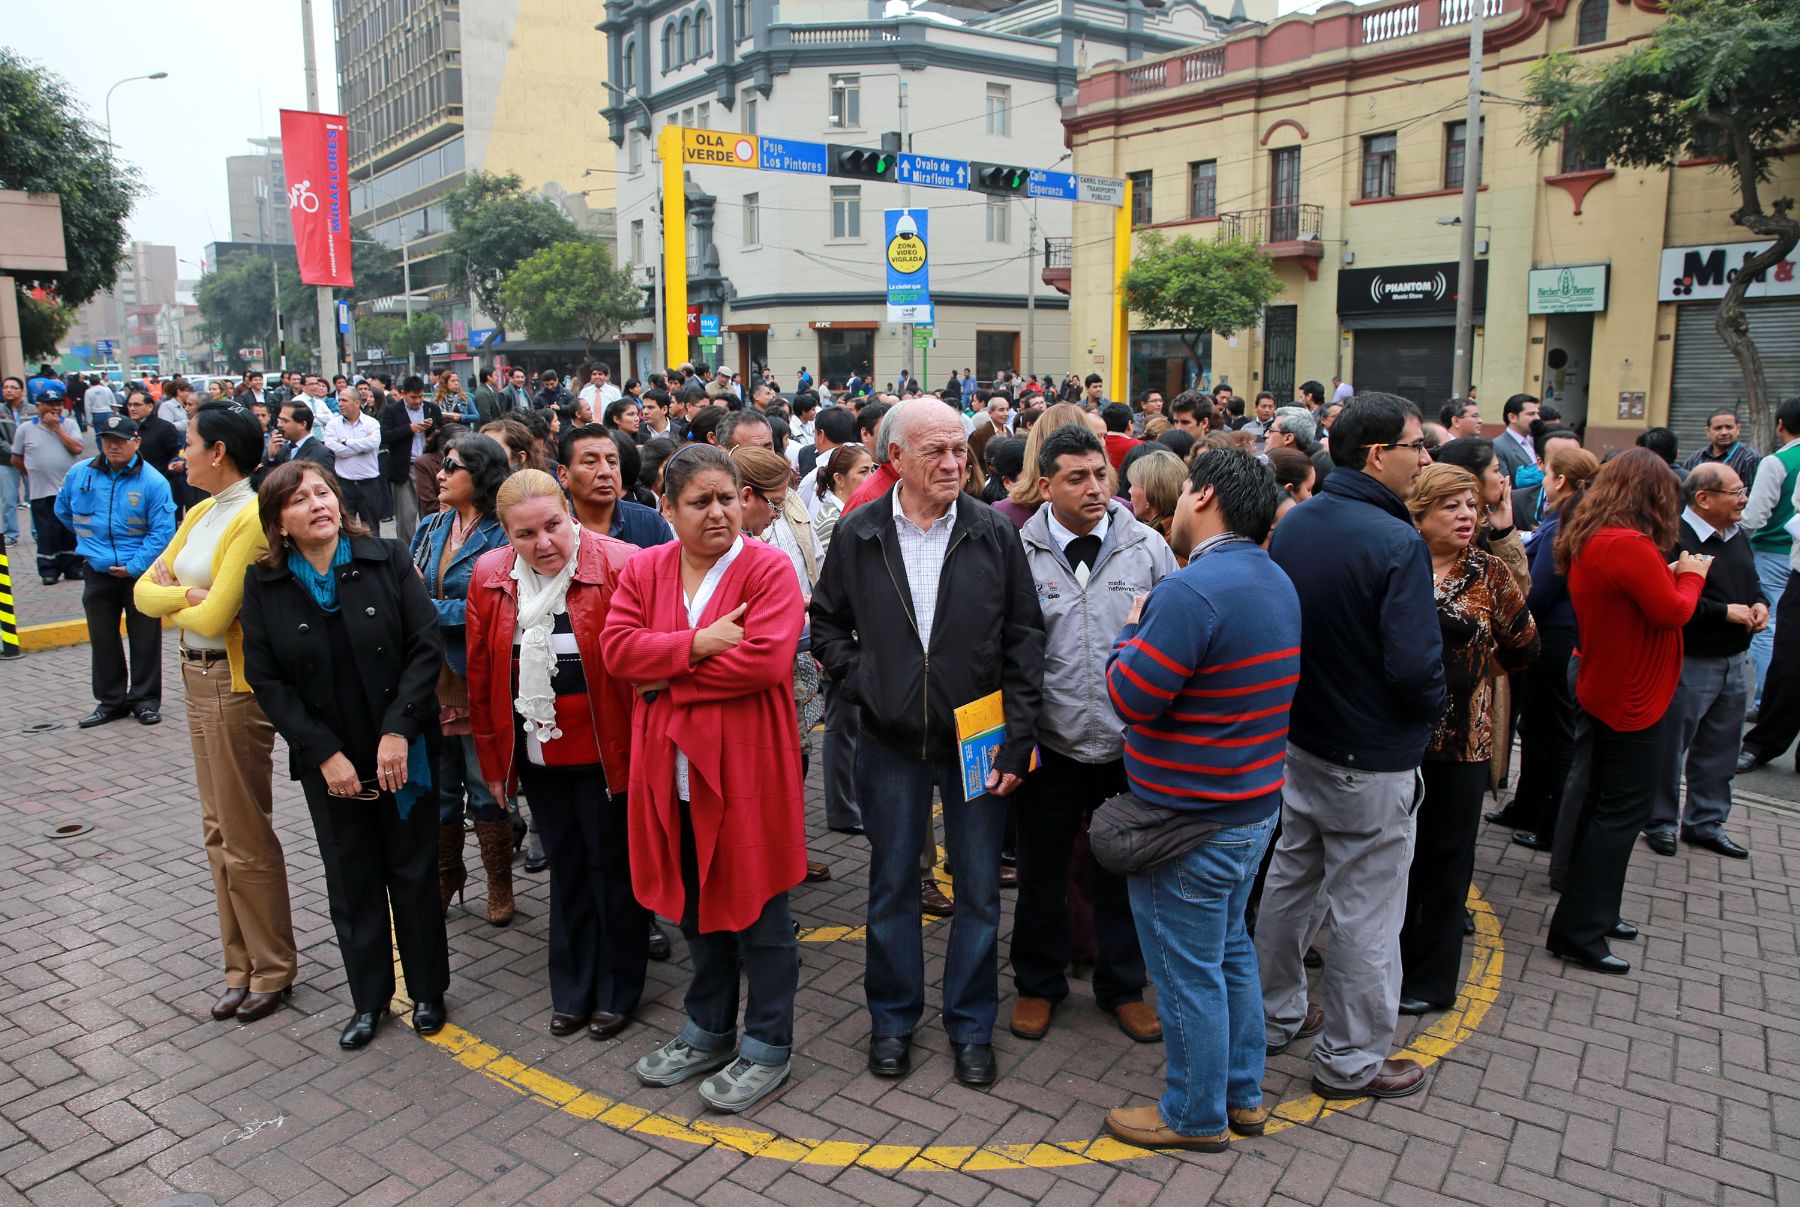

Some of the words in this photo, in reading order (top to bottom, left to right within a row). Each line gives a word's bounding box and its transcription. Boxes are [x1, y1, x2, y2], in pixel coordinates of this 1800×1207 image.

[695, 134, 725, 147] OLA
[763, 139, 786, 156] Psje.
[686, 148, 734, 163] VERDE
[763, 156, 781, 168] Los
[784, 157, 822, 173] Pintores
[915, 158, 938, 171] Ovalo
[940, 160, 950, 172] de
[912, 170, 955, 186] Miraflores
[1029, 170, 1047, 183] Calle
[1080, 176, 1097, 185] CARRIL
[1098, 178, 1124, 188] EXCLUSIVO
[1030, 182, 1064, 197] Esperanza
[1086, 185, 1117, 195] TRANSPORTE
[327, 234, 337, 277] renuévate
[1384, 281, 1432, 293] PHANTOM
[688, 313, 697, 323] FC
